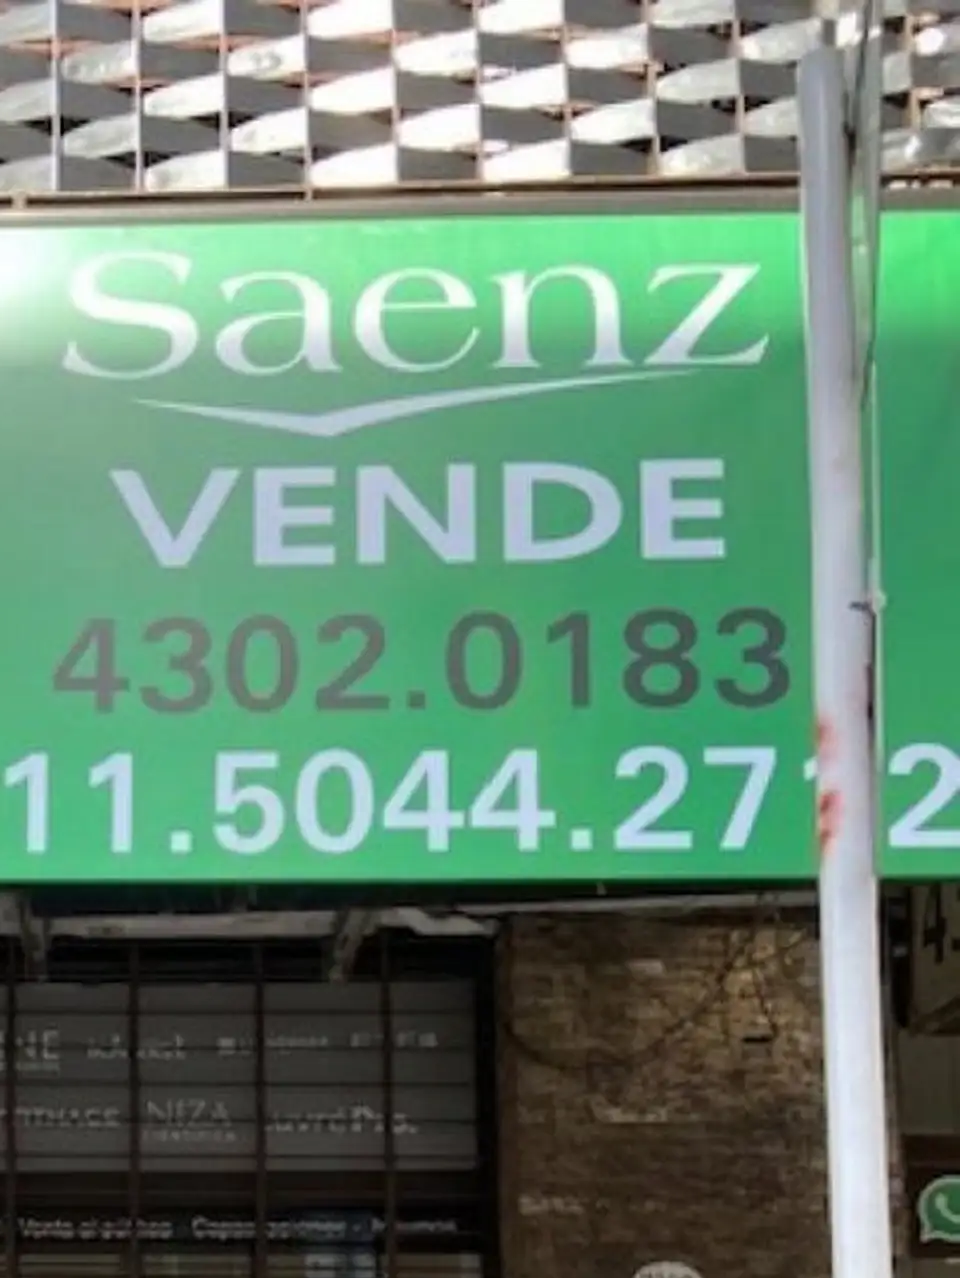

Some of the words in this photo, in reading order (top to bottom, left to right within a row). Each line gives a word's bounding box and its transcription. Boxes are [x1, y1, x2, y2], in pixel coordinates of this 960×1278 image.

[61, 250, 771, 379] Saenz
[109, 458, 727, 569] VENDE
[52, 606, 792, 715] 4302.0183
[4, 745, 960, 854] 11.5044.272
